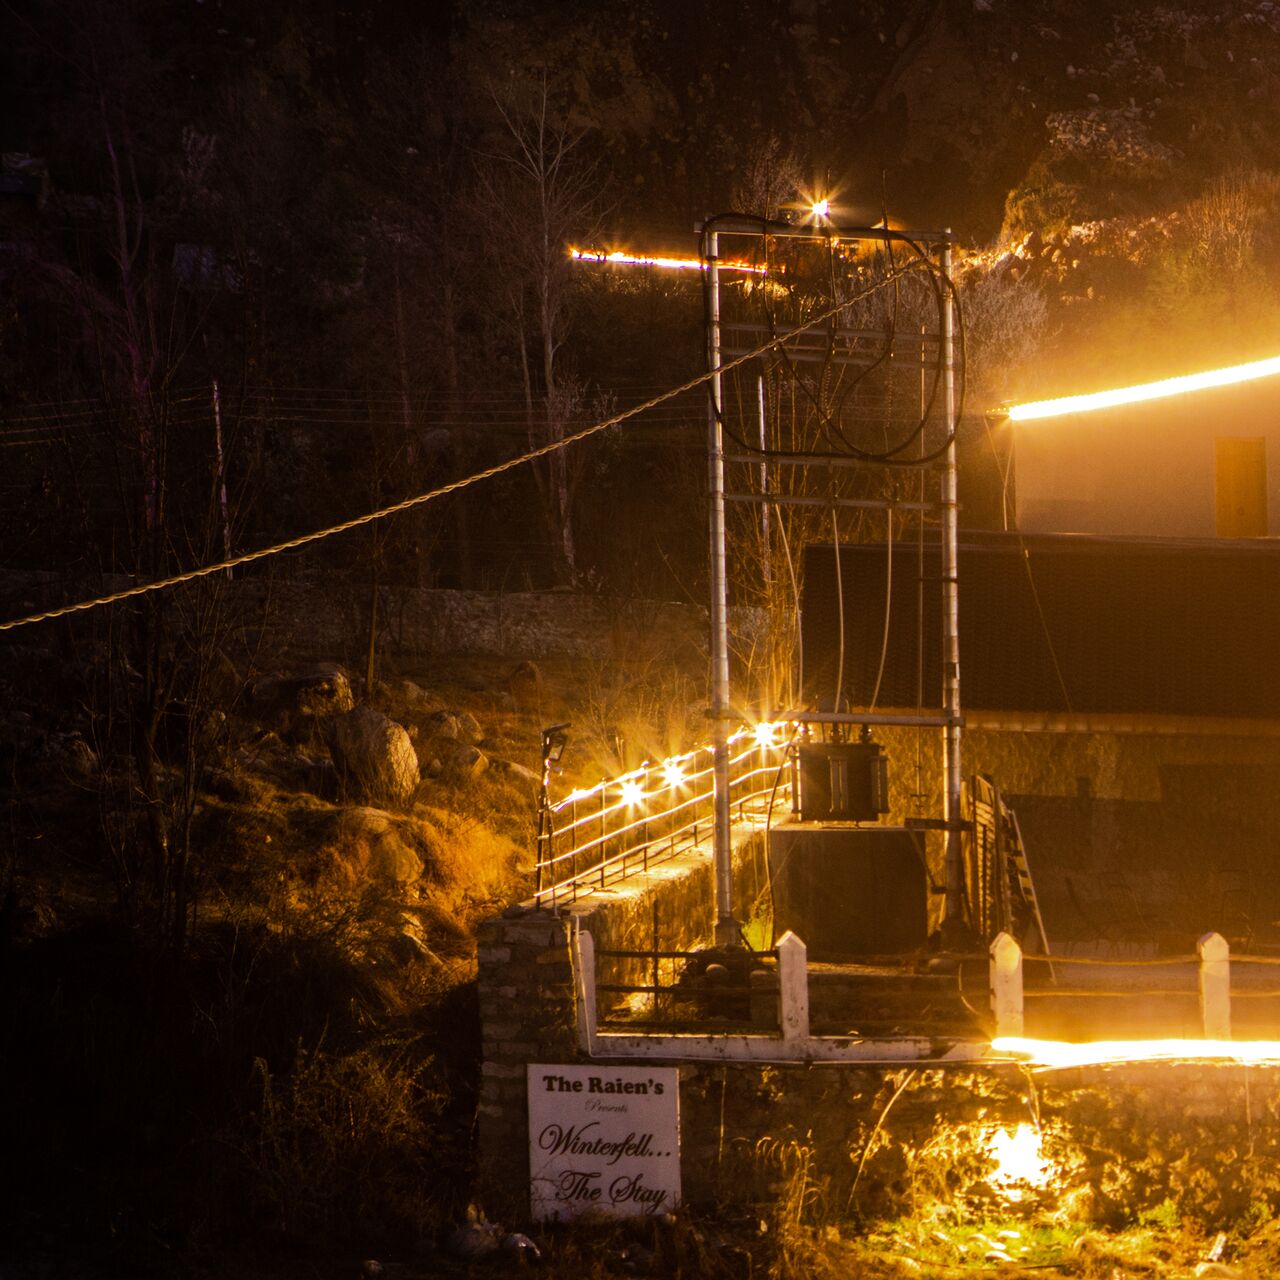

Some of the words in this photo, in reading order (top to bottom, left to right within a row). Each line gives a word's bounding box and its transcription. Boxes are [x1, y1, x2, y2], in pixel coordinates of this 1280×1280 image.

[543, 1075, 583, 1093] The
[588, 1077, 664, 1095] Raien's
[585, 1100, 629, 1113] Presents
[538, 1121, 672, 1166] Winterfell...
[555, 1170, 601, 1201] The
[608, 1173, 668, 1213] Stay
